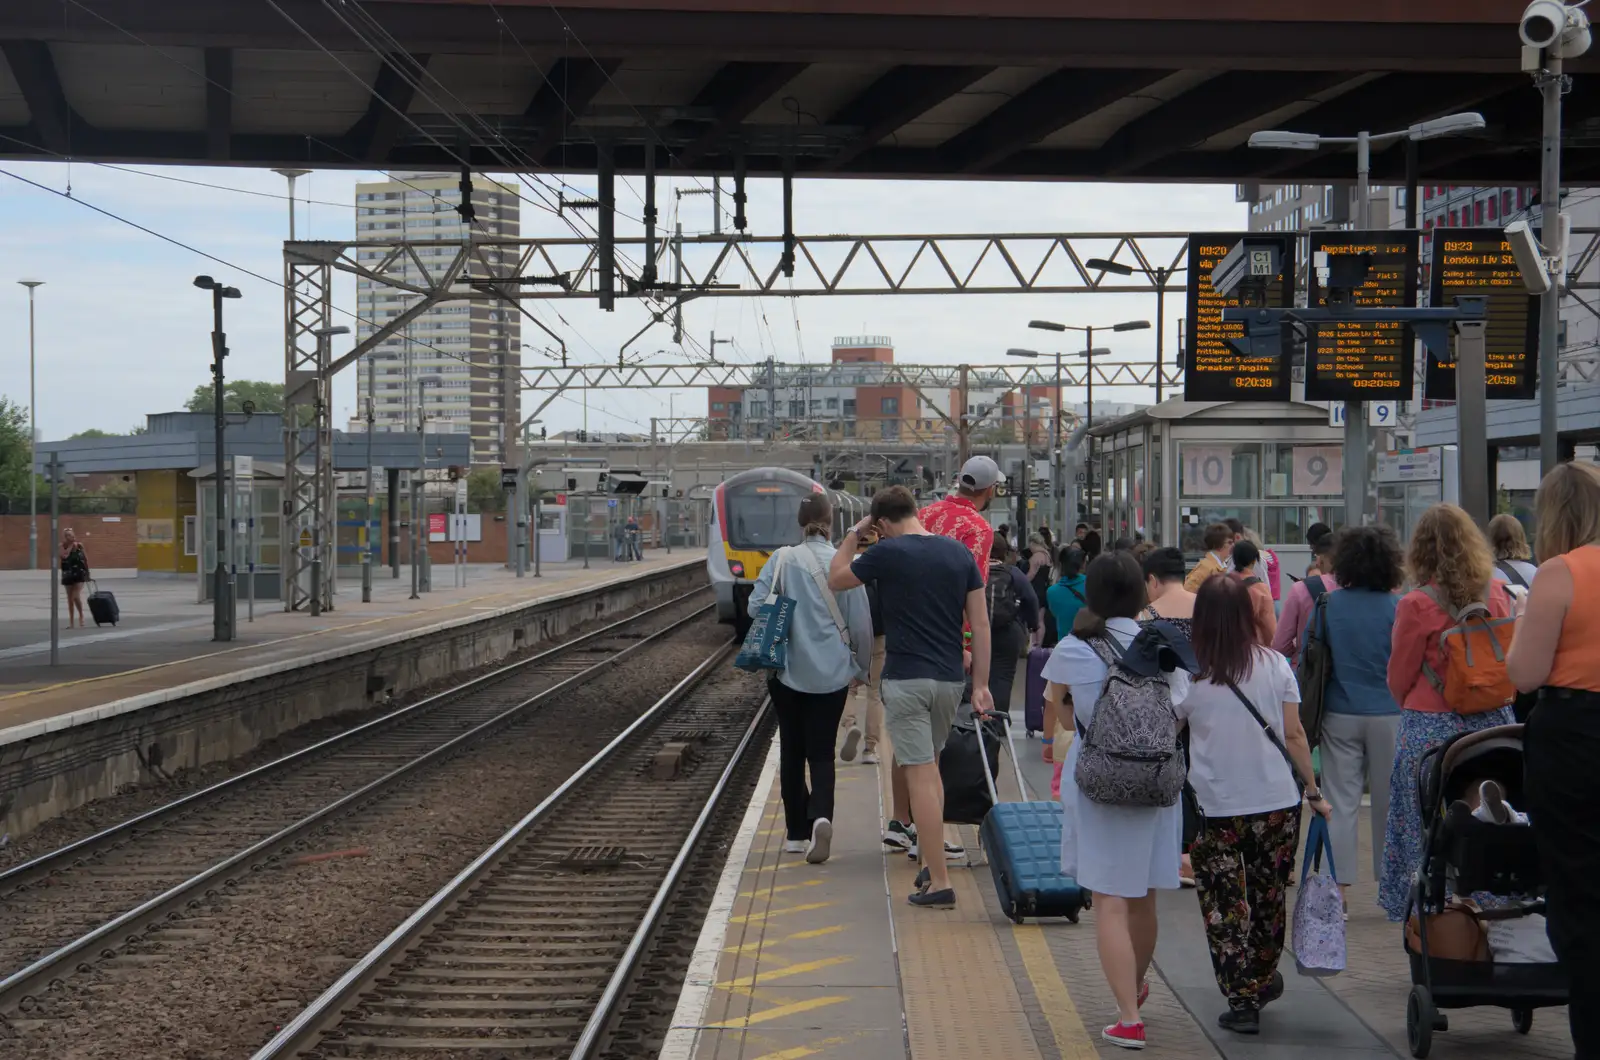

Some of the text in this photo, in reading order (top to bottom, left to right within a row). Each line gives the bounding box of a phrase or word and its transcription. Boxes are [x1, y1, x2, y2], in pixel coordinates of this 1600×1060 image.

[1199, 246, 1227, 256] 09:20
[1321, 244, 1377, 255] Departures
[1444, 241, 1512, 251] 09:23 Pl
[1253, 252, 1269, 262] C1
[1443, 255, 1479, 265] London
[1482, 255, 1498, 265] Liv
[1199, 259, 1213, 269] via
[1254, 264, 1271, 275] M1
[1239, 364, 1269, 372] Anglia
[1353, 379, 1400, 388] 09:20:39
[1376, 405, 1389, 422] 9
[1190, 455, 1224, 486] 10
[1306, 455, 1329, 486] 9
[775, 602, 789, 633] DAUNT
